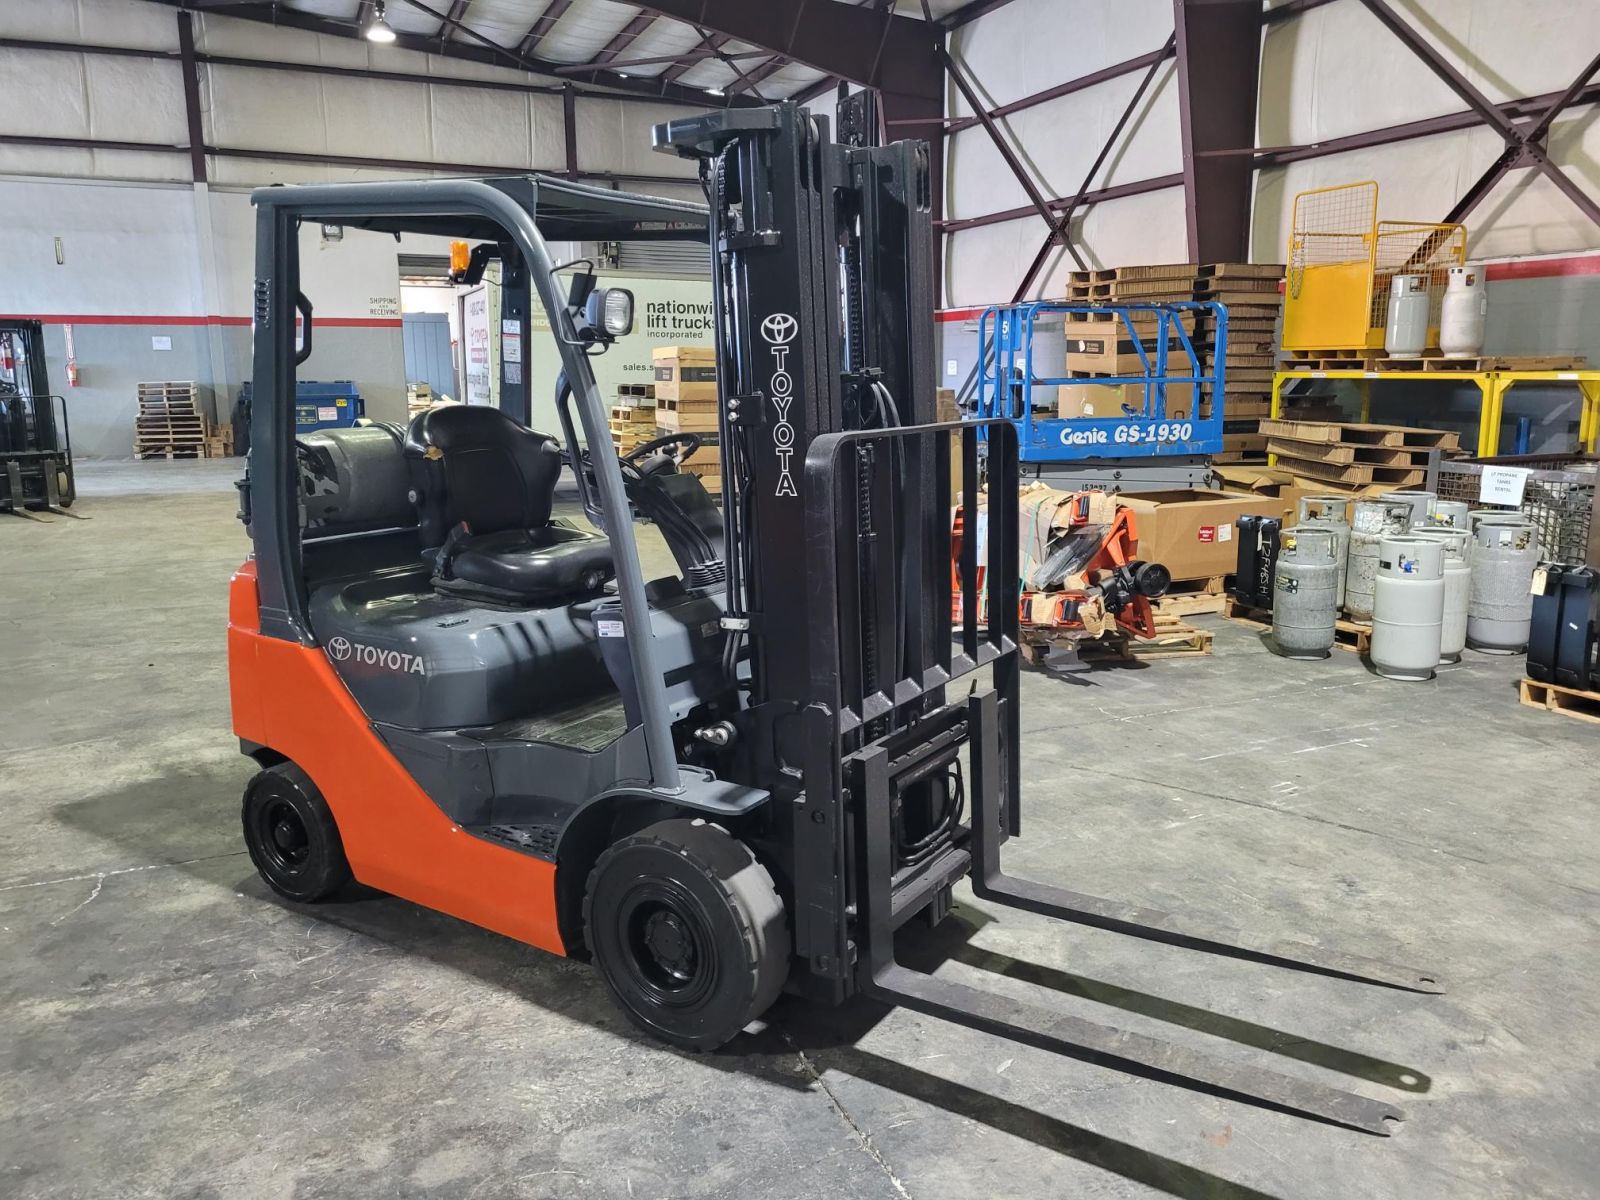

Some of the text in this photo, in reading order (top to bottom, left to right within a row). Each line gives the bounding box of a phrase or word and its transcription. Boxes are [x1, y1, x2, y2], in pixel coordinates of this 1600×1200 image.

[369, 308, 399, 316] RECEIVING
[647, 300, 714, 315] nationwi
[647, 314, 667, 329] lift
[647, 330, 703, 340] incorporated
[623, 363, 655, 371] sales.s
[771, 345, 798, 497] TOYOTA
[1060, 423, 1193, 445] Genie GS-1930
[354, 643, 425, 676] TOYOTA
